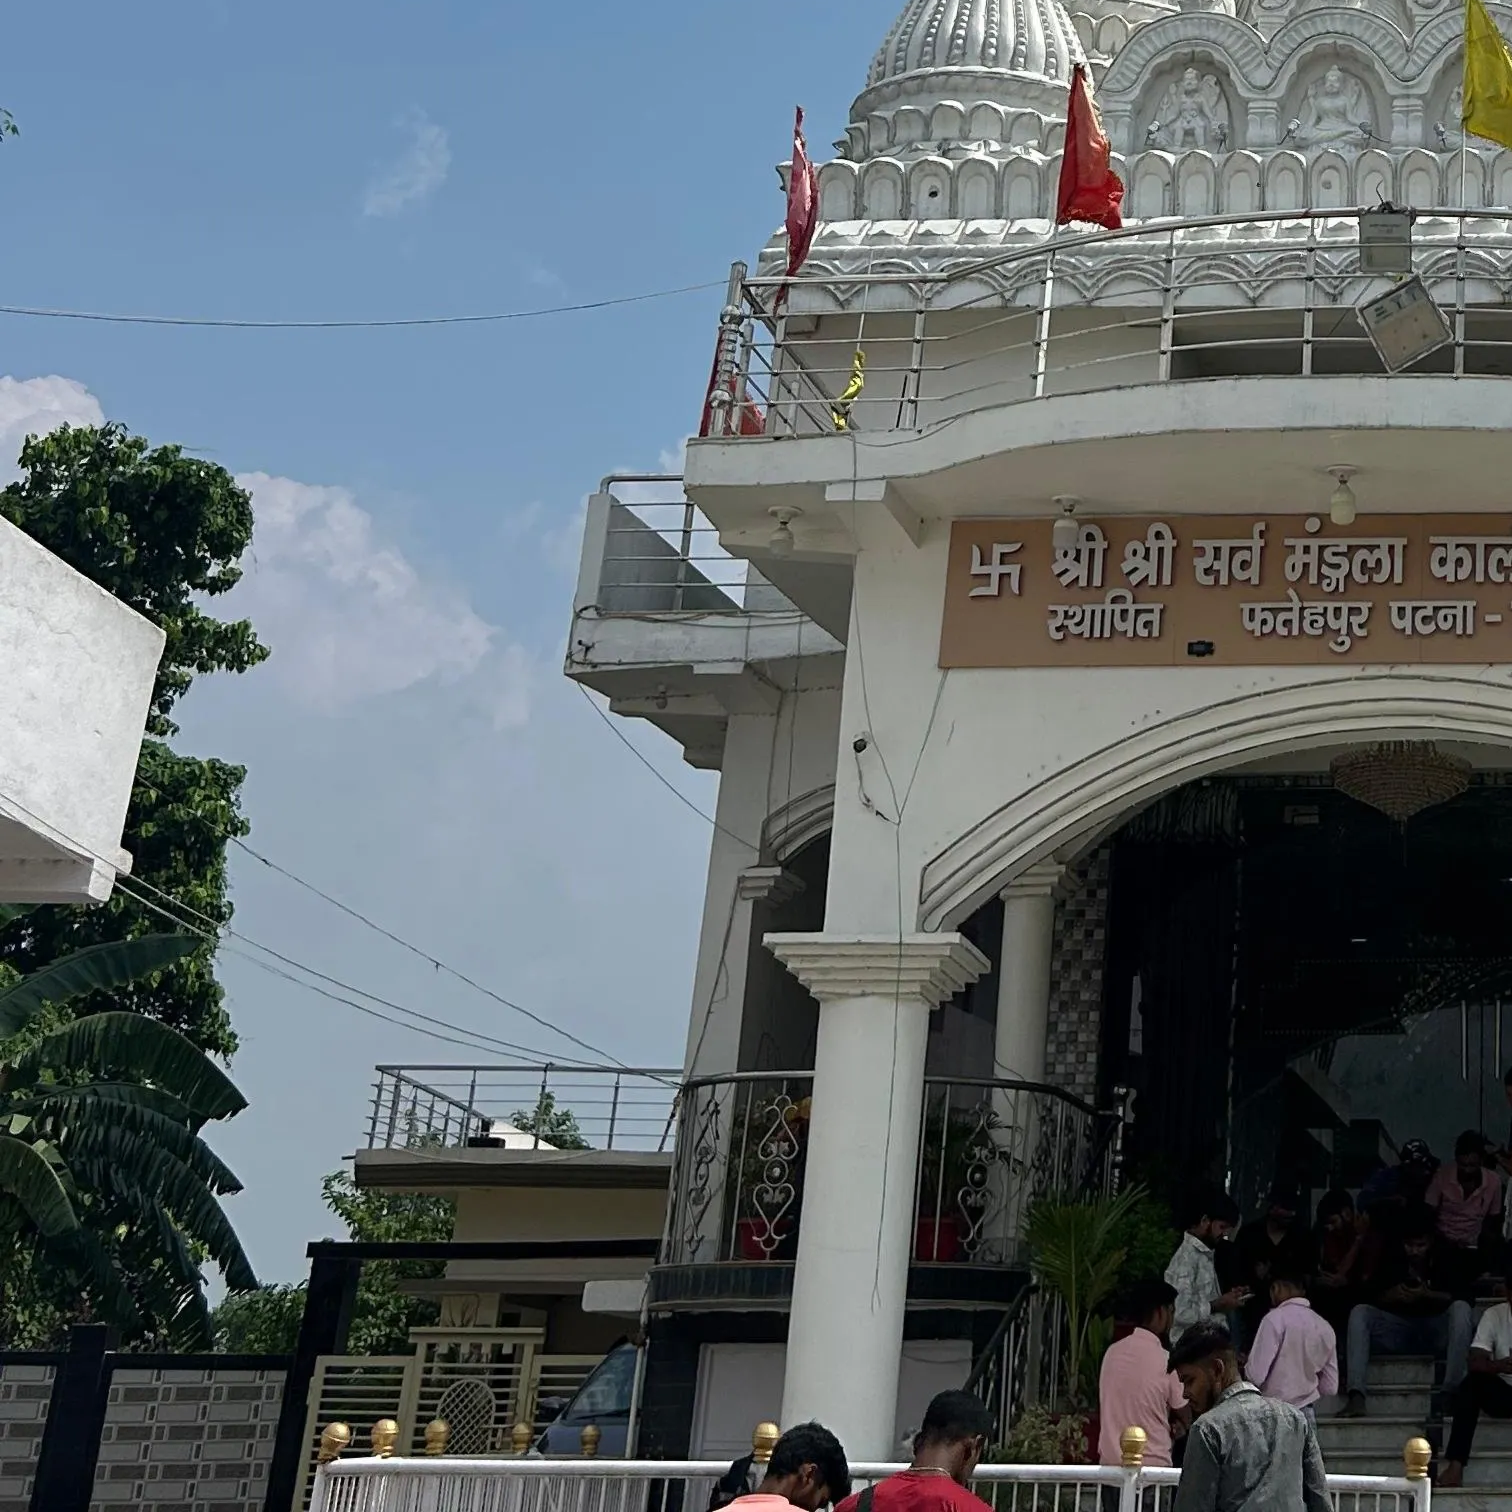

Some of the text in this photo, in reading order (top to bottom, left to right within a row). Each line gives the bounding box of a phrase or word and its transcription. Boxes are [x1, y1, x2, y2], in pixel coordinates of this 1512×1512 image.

[1120, 521, 1177, 587] श्री
[1192, 521, 1266, 586] सर्व
[1047, 588, 1163, 641] स्थापित
[1240, 588, 1373, 652] फतेहपुर
